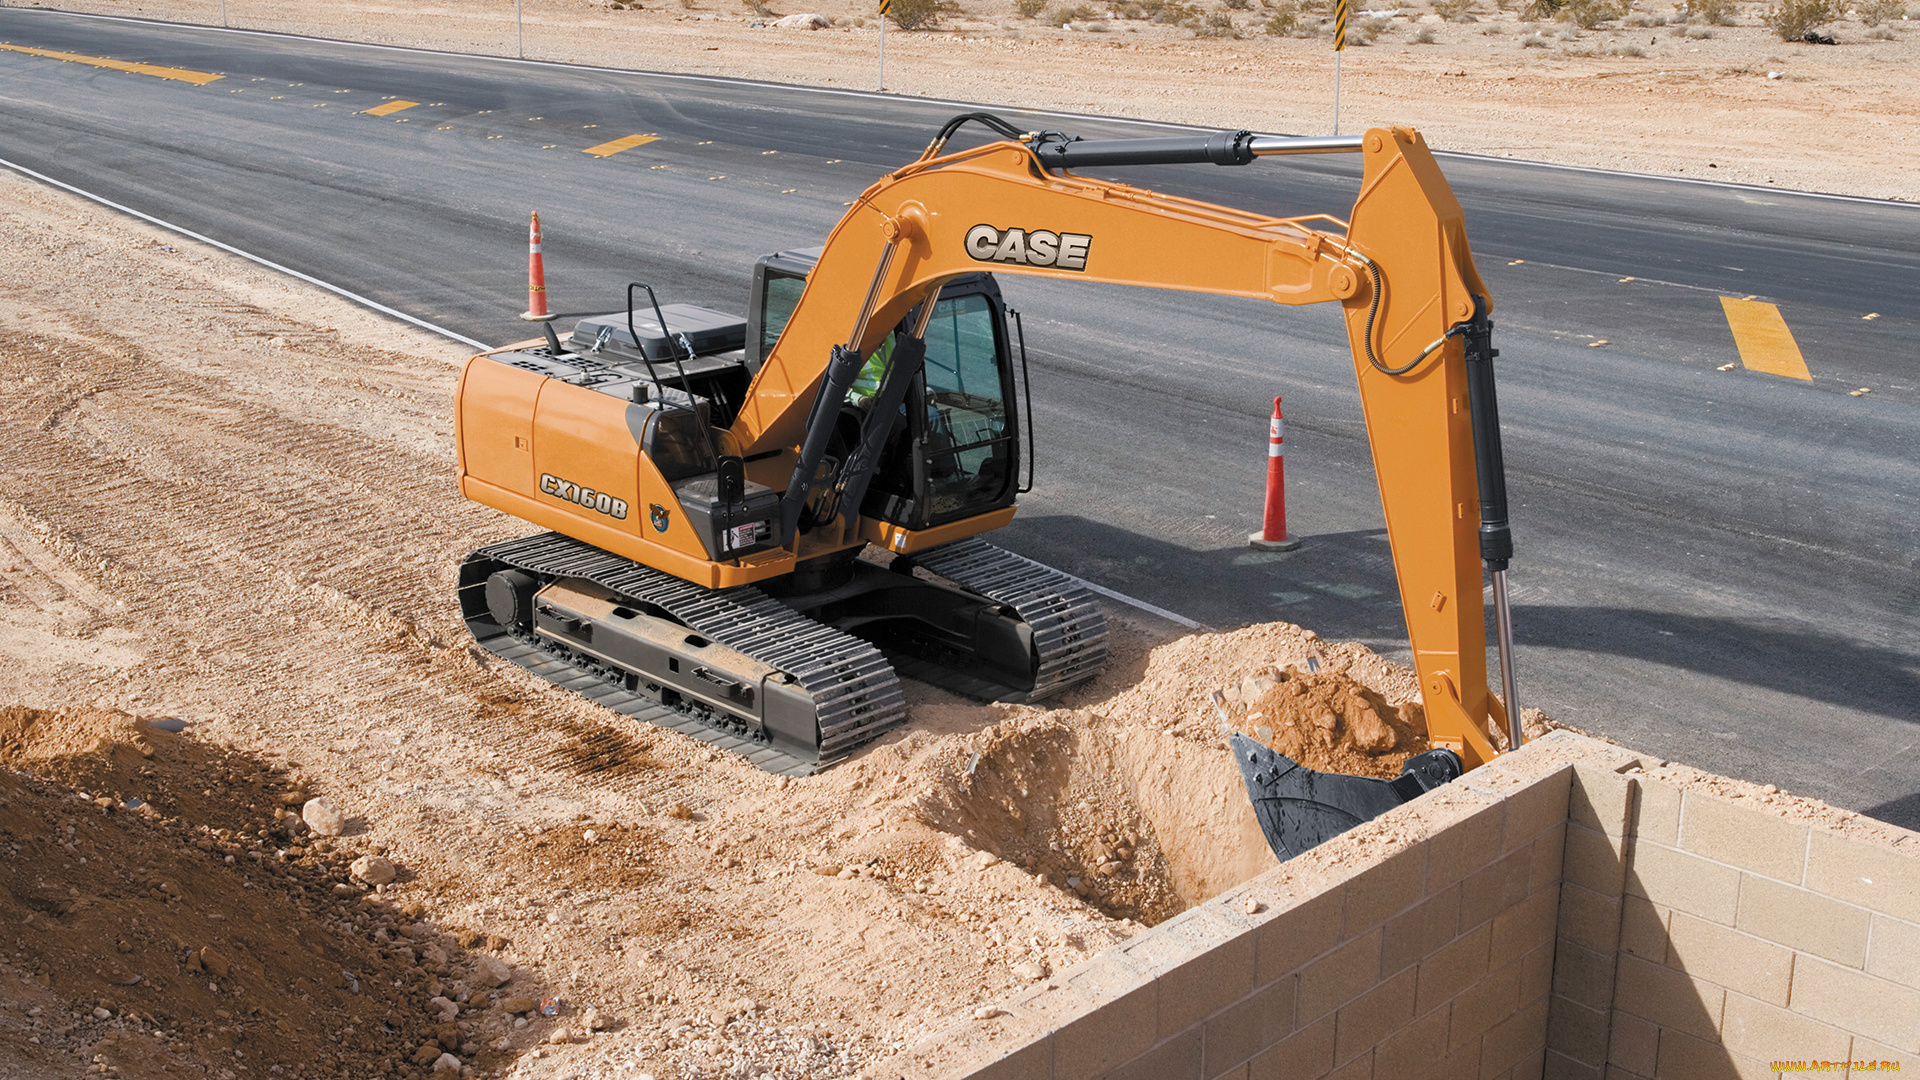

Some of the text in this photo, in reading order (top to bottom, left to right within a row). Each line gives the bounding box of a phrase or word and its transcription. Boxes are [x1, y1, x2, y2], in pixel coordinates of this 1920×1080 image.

[965, 224, 1092, 271] CASE
[938, 300, 966, 313] CASE
[540, 473, 629, 520] CX160B
